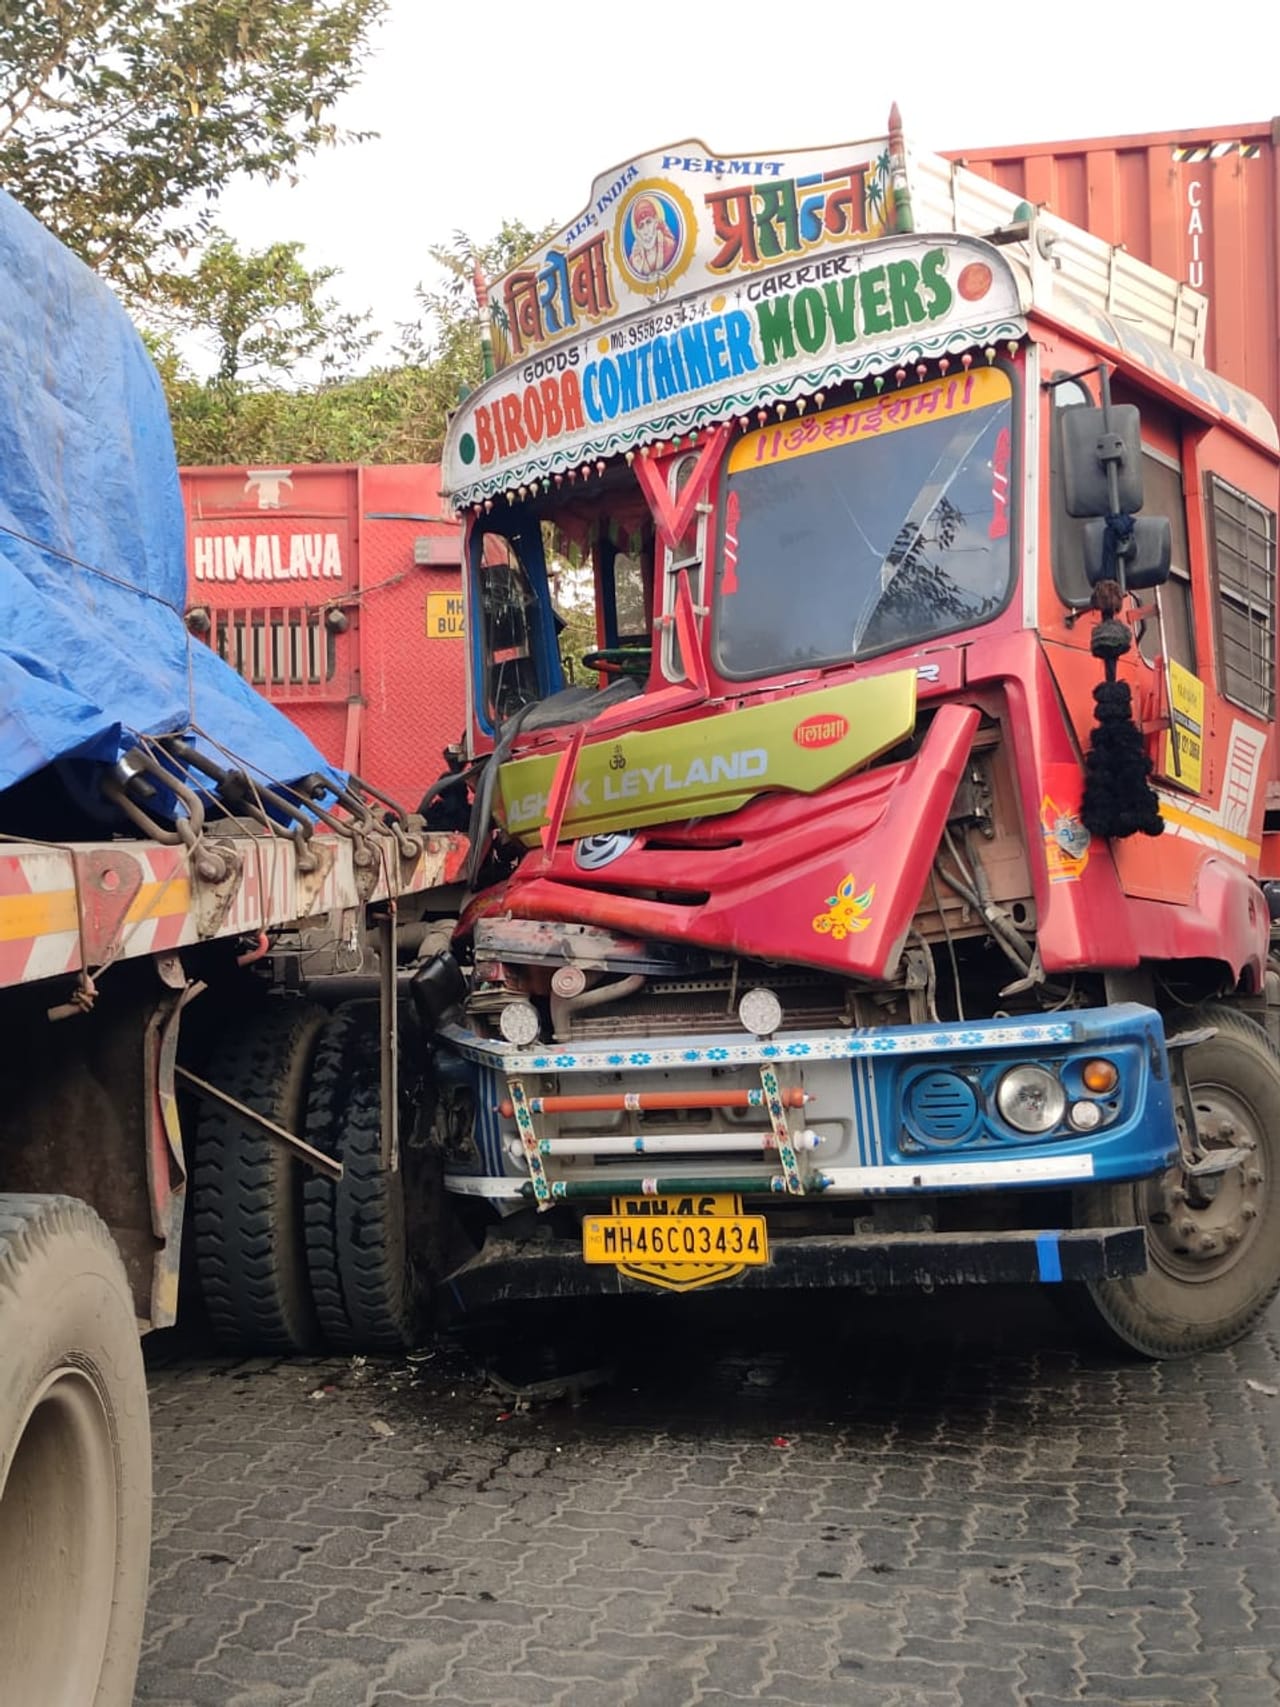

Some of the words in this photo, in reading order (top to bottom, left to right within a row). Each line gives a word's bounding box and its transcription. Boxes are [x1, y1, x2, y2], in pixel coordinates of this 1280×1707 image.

[566, 213, 596, 245] ALL
[597, 165, 639, 213] INDIA
[662, 156, 784, 176] PERMIT
[704, 162, 870, 268] प्रसन्न
[1188, 181, 1203, 287] CAIU
[474, 369, 585, 465] BIROBA
[583, 309, 759, 425] CONTAINER
[754, 248, 952, 366] MOVERS
[523, 346, 580, 384] GOODS
[747, 255, 850, 302] CARRIER
[195, 533, 342, 582] HIMALAYA
[604, 748, 767, 800] LEYLAND
[604, 1226, 759, 1254] MH46CQ3434
